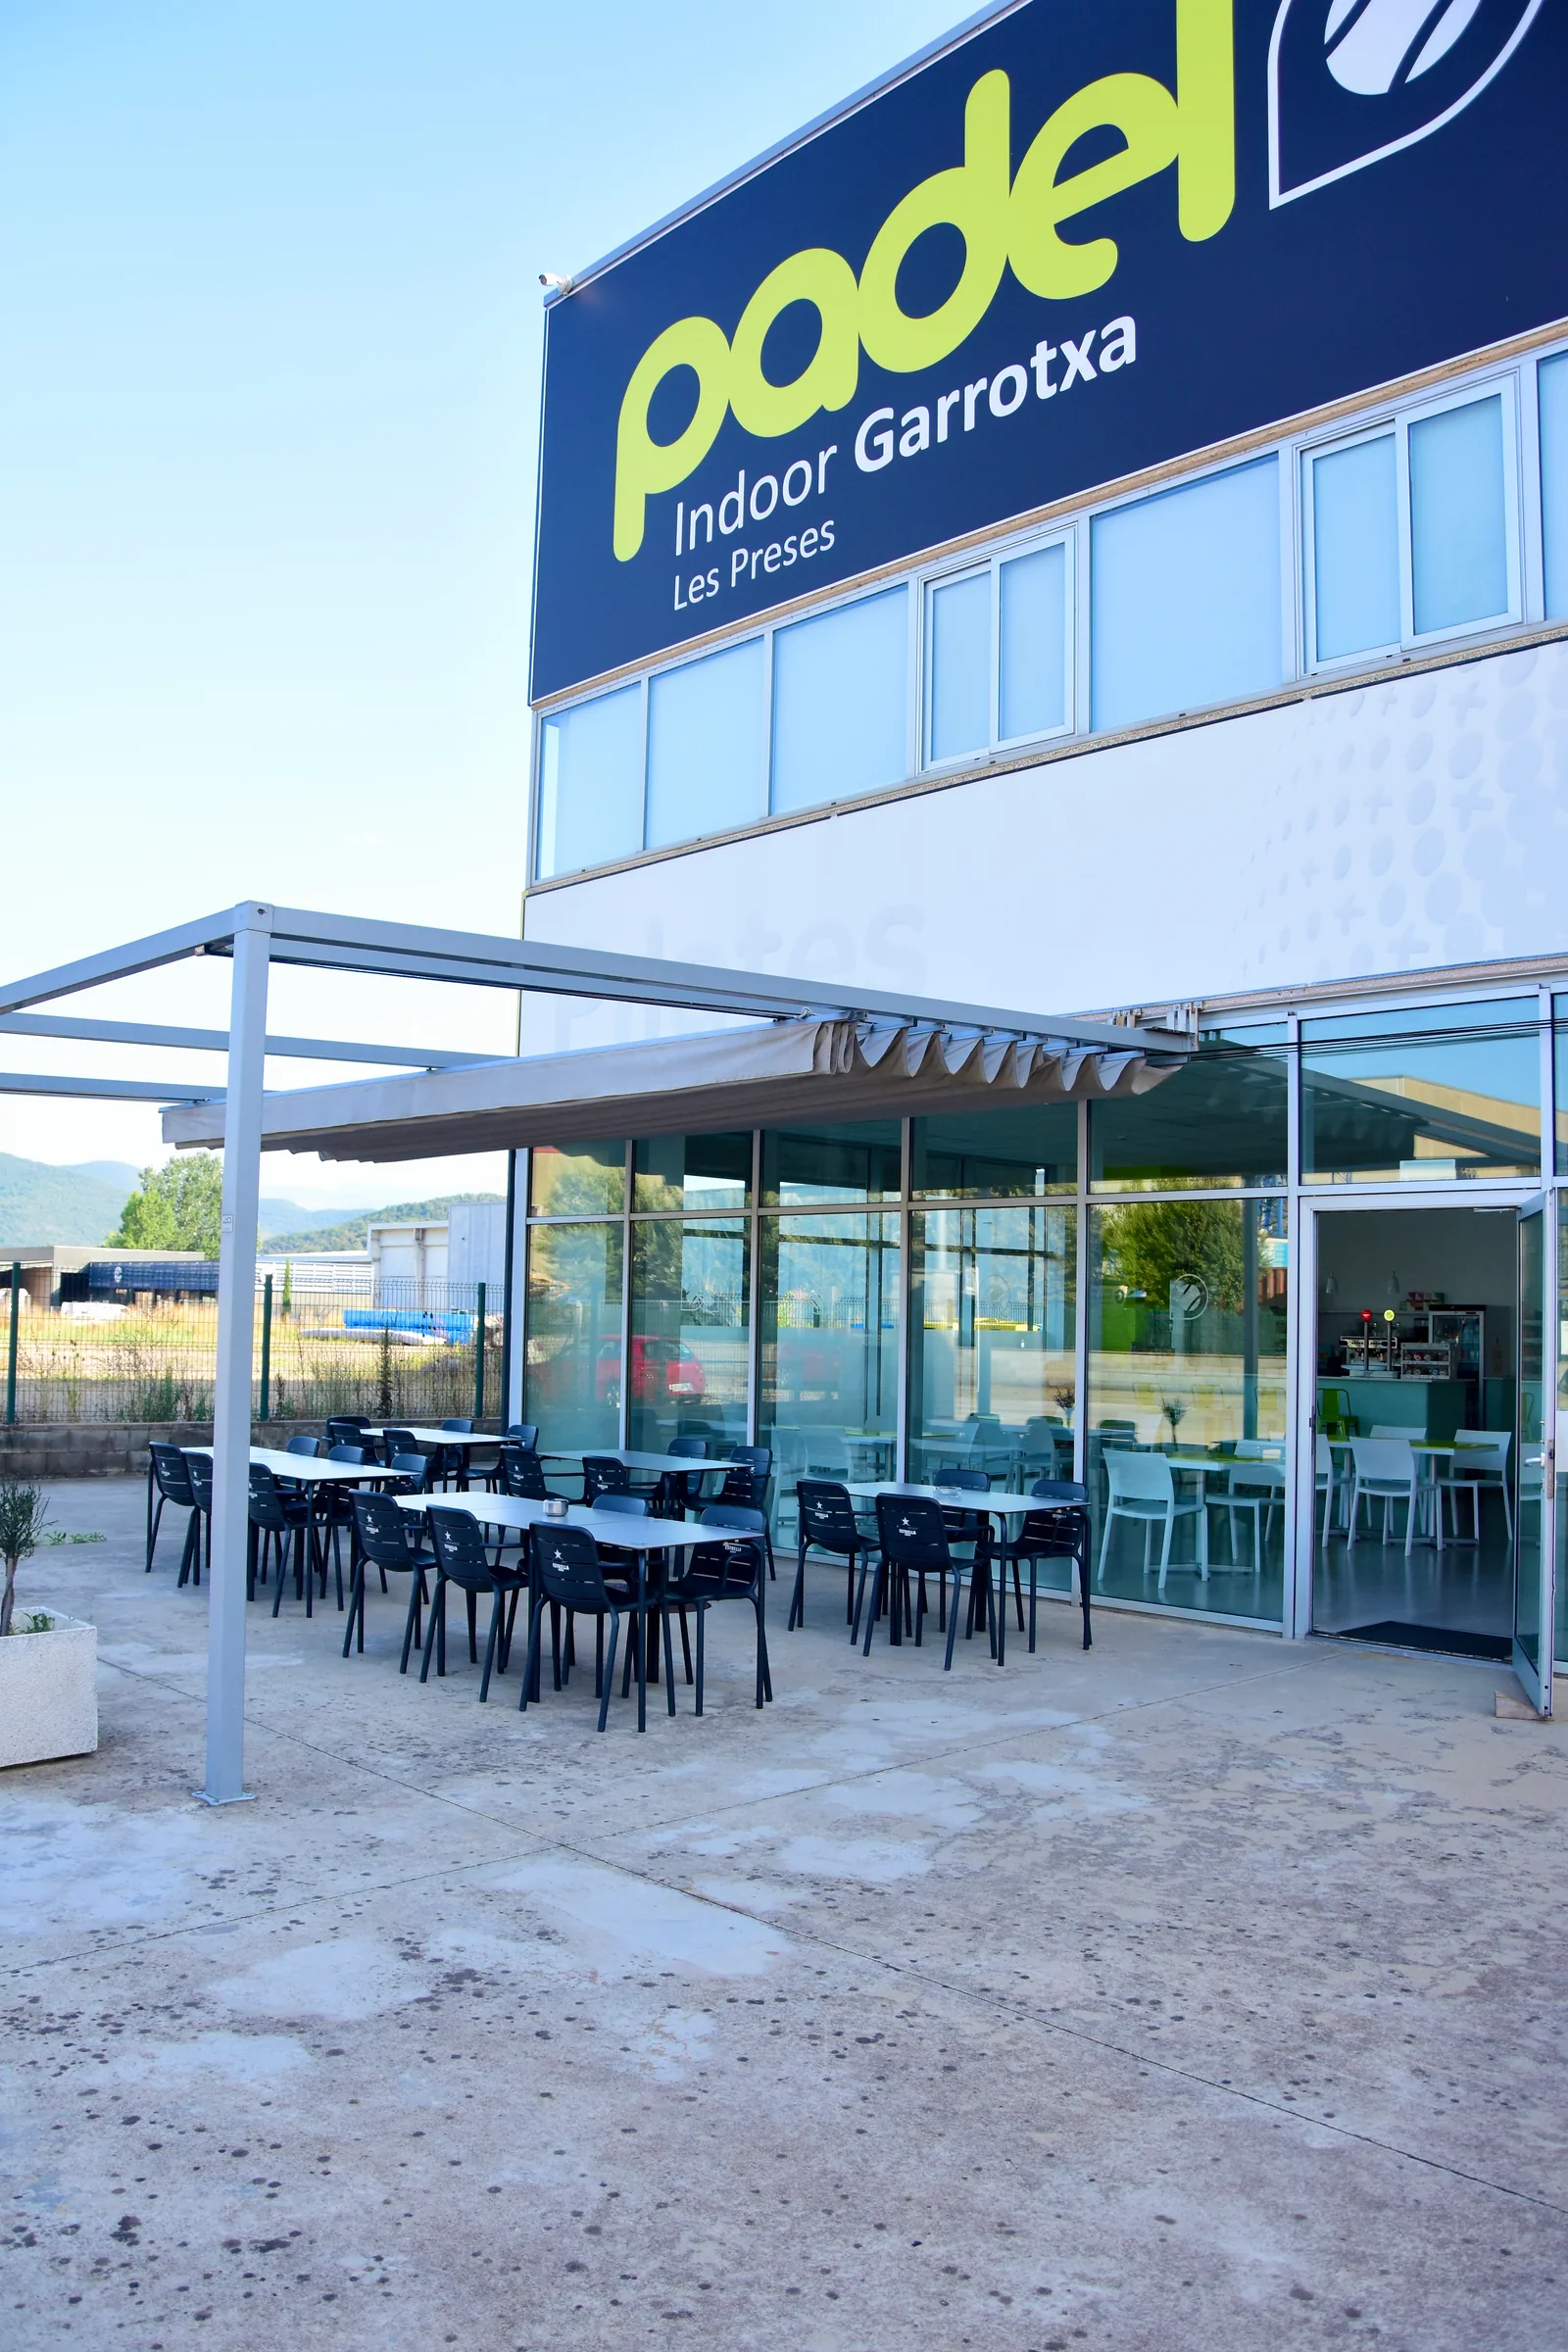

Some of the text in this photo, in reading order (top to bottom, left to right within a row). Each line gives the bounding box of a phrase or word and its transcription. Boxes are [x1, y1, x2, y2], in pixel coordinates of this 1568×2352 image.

[614, 0, 1236, 562] padel
[675, 316, 1137, 557] Indoor Garrotxa
[673, 519, 836, 612] Les Preses
